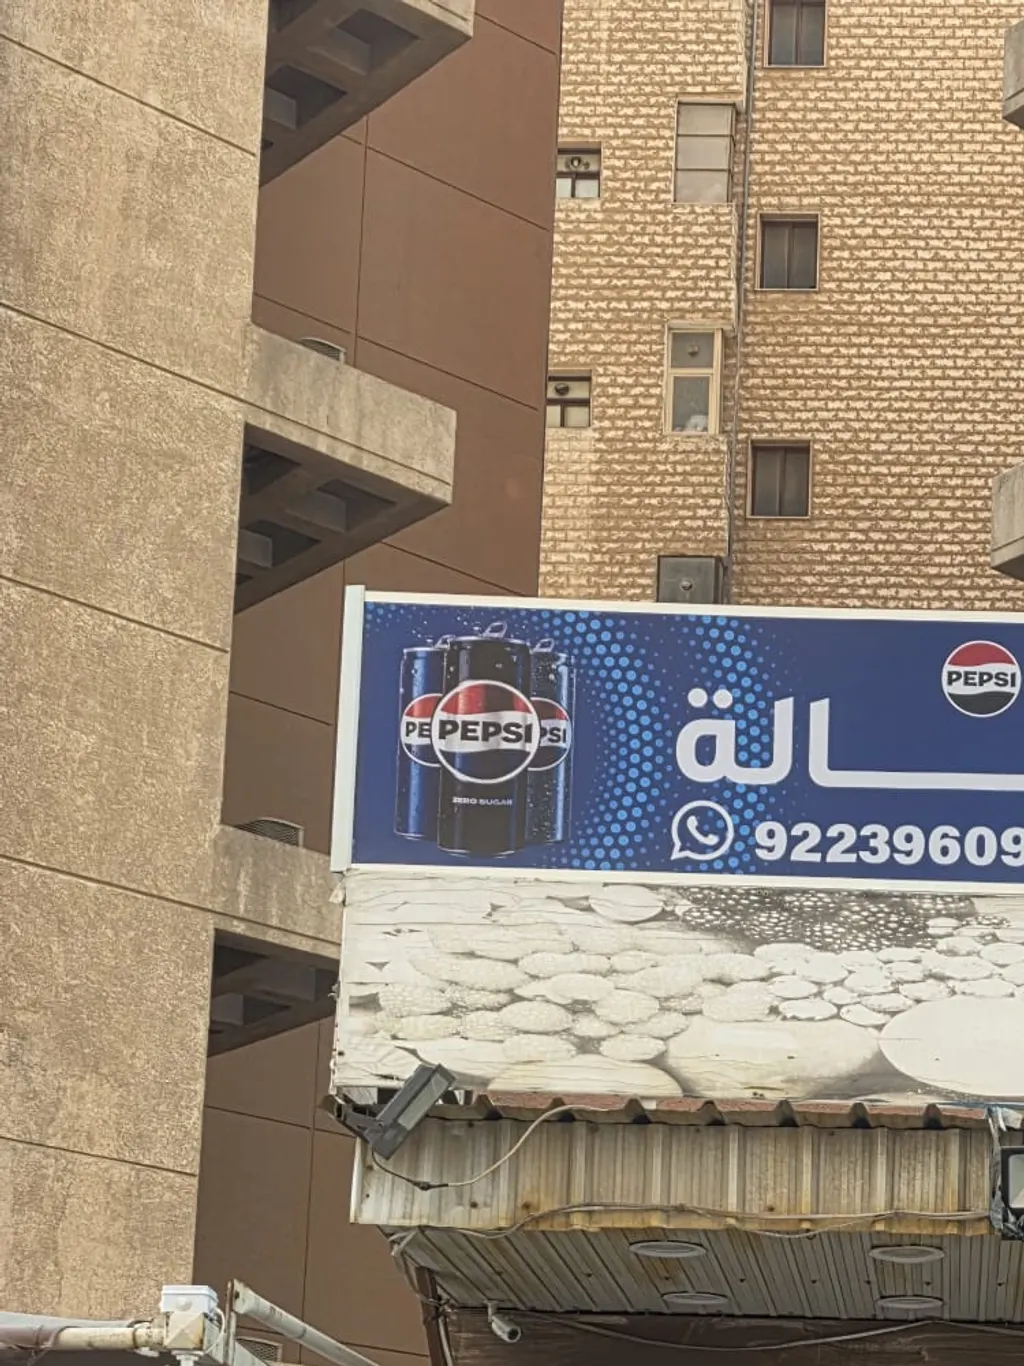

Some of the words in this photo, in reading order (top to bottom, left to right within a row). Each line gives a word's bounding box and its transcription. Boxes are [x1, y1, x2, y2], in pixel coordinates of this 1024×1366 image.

[947, 670, 1017, 688] PEPSI
[438, 718, 533, 745] PEPSI
[452, 796, 477, 805] ZERO
[478, 798, 513, 806] SUGAR
